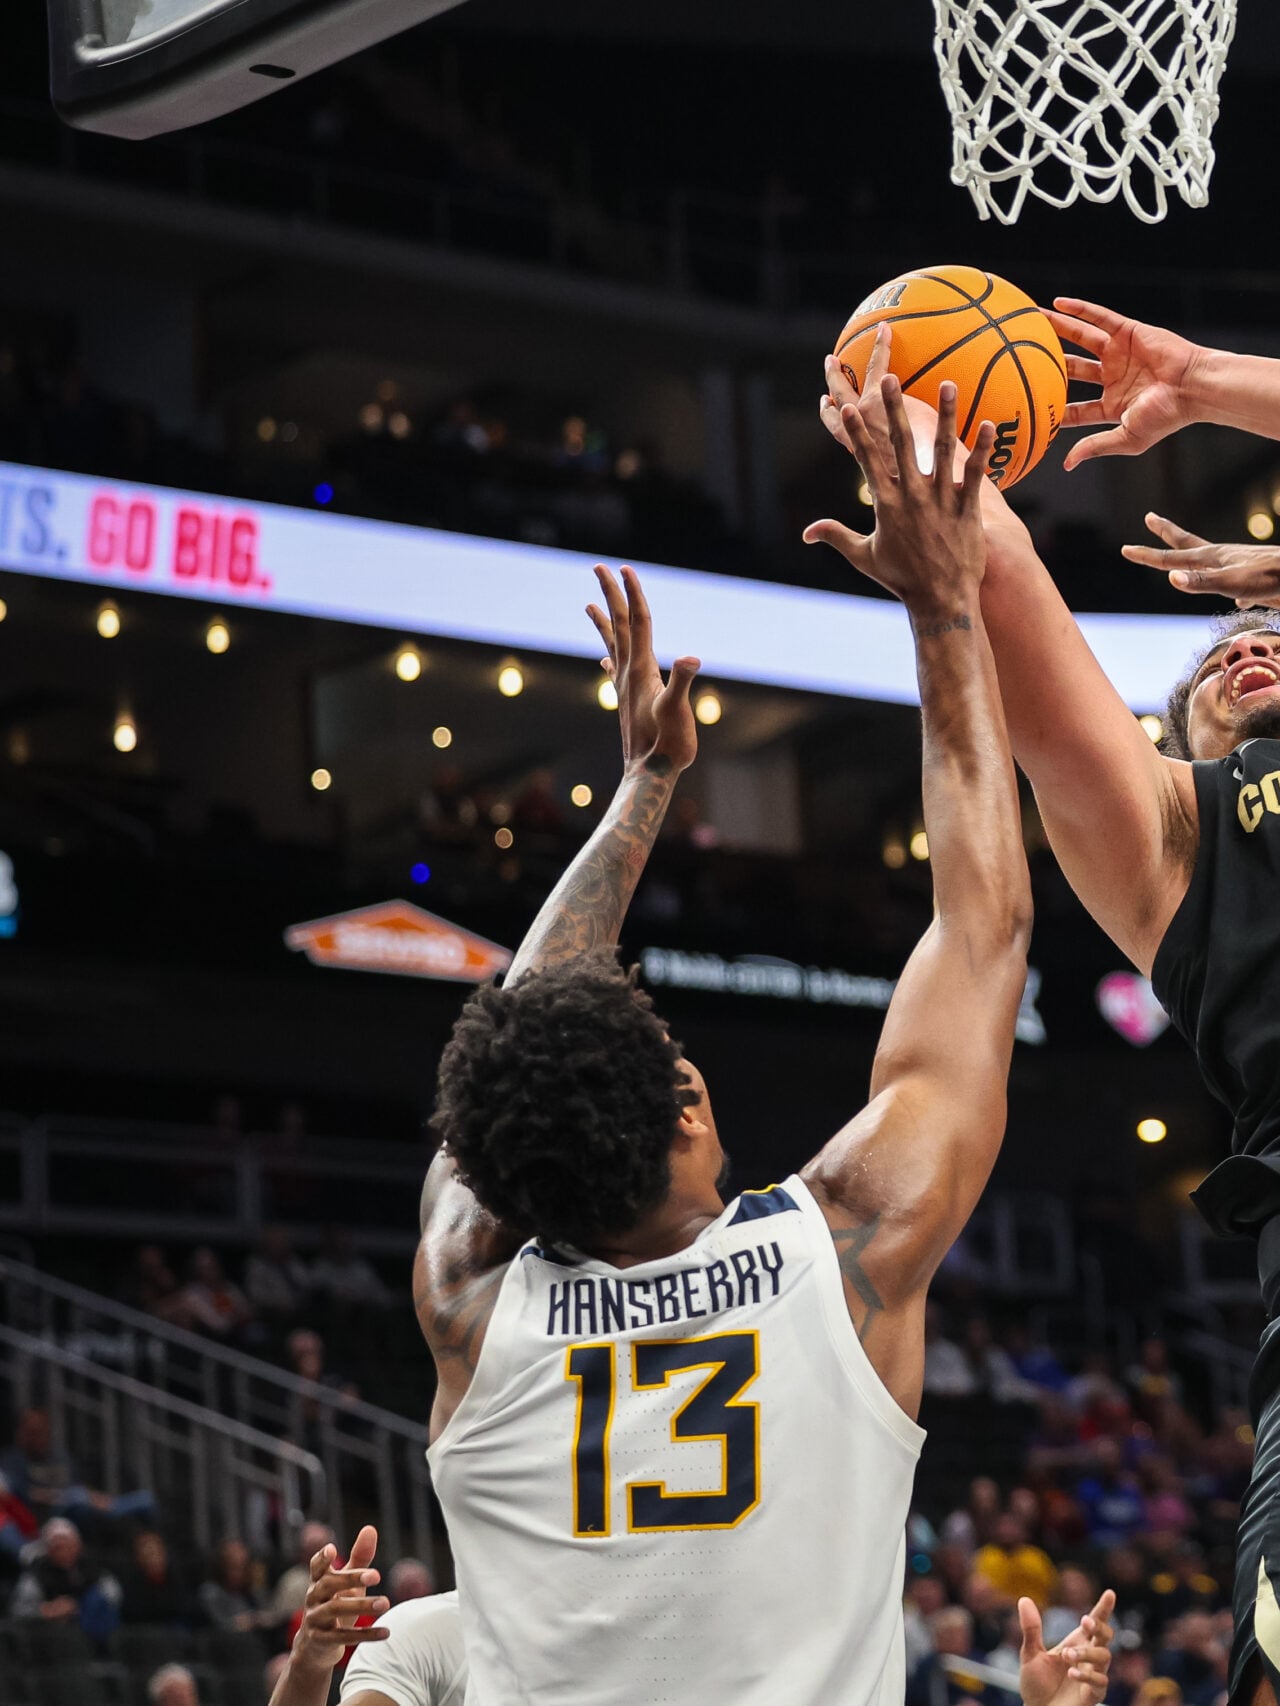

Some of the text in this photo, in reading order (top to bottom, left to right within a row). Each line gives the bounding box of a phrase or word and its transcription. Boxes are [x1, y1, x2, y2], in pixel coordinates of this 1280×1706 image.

[88, 492, 157, 573] GO
[172, 506, 272, 590] BIG.
[546, 1241, 784, 1336] HANSBERRY
[564, 1329, 760, 1538] 13
